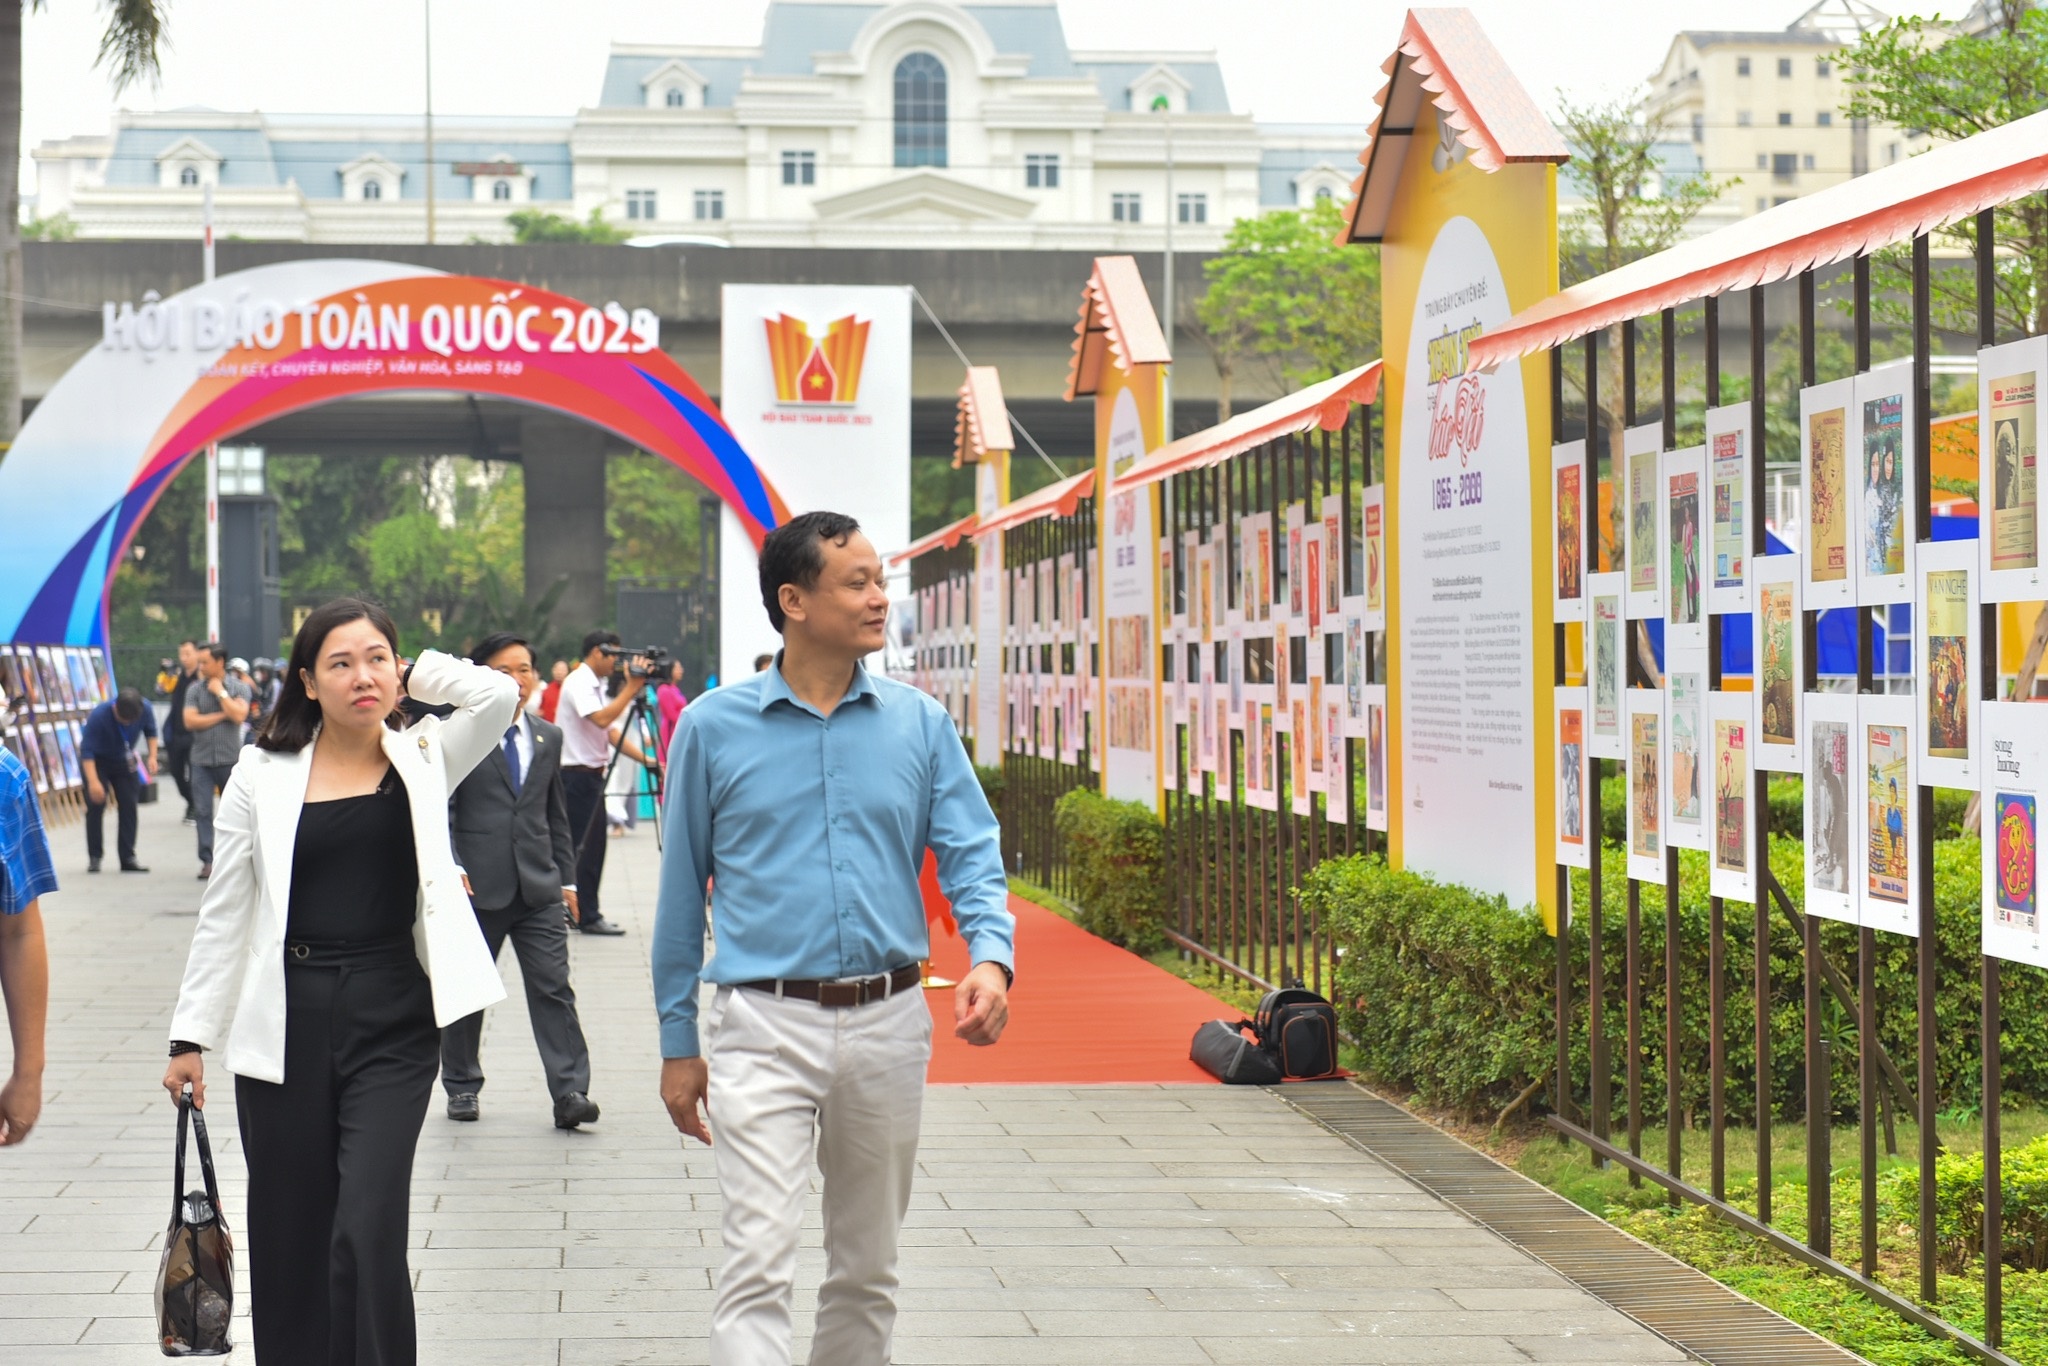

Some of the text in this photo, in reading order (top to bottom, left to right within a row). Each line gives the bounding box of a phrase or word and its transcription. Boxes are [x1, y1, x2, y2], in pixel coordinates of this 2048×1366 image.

[103, 288, 180, 363] HỘI
[196, 288, 285, 351] BÁO
[293, 292, 410, 351] TOÀN
[420, 288, 541, 358] QUỐC
